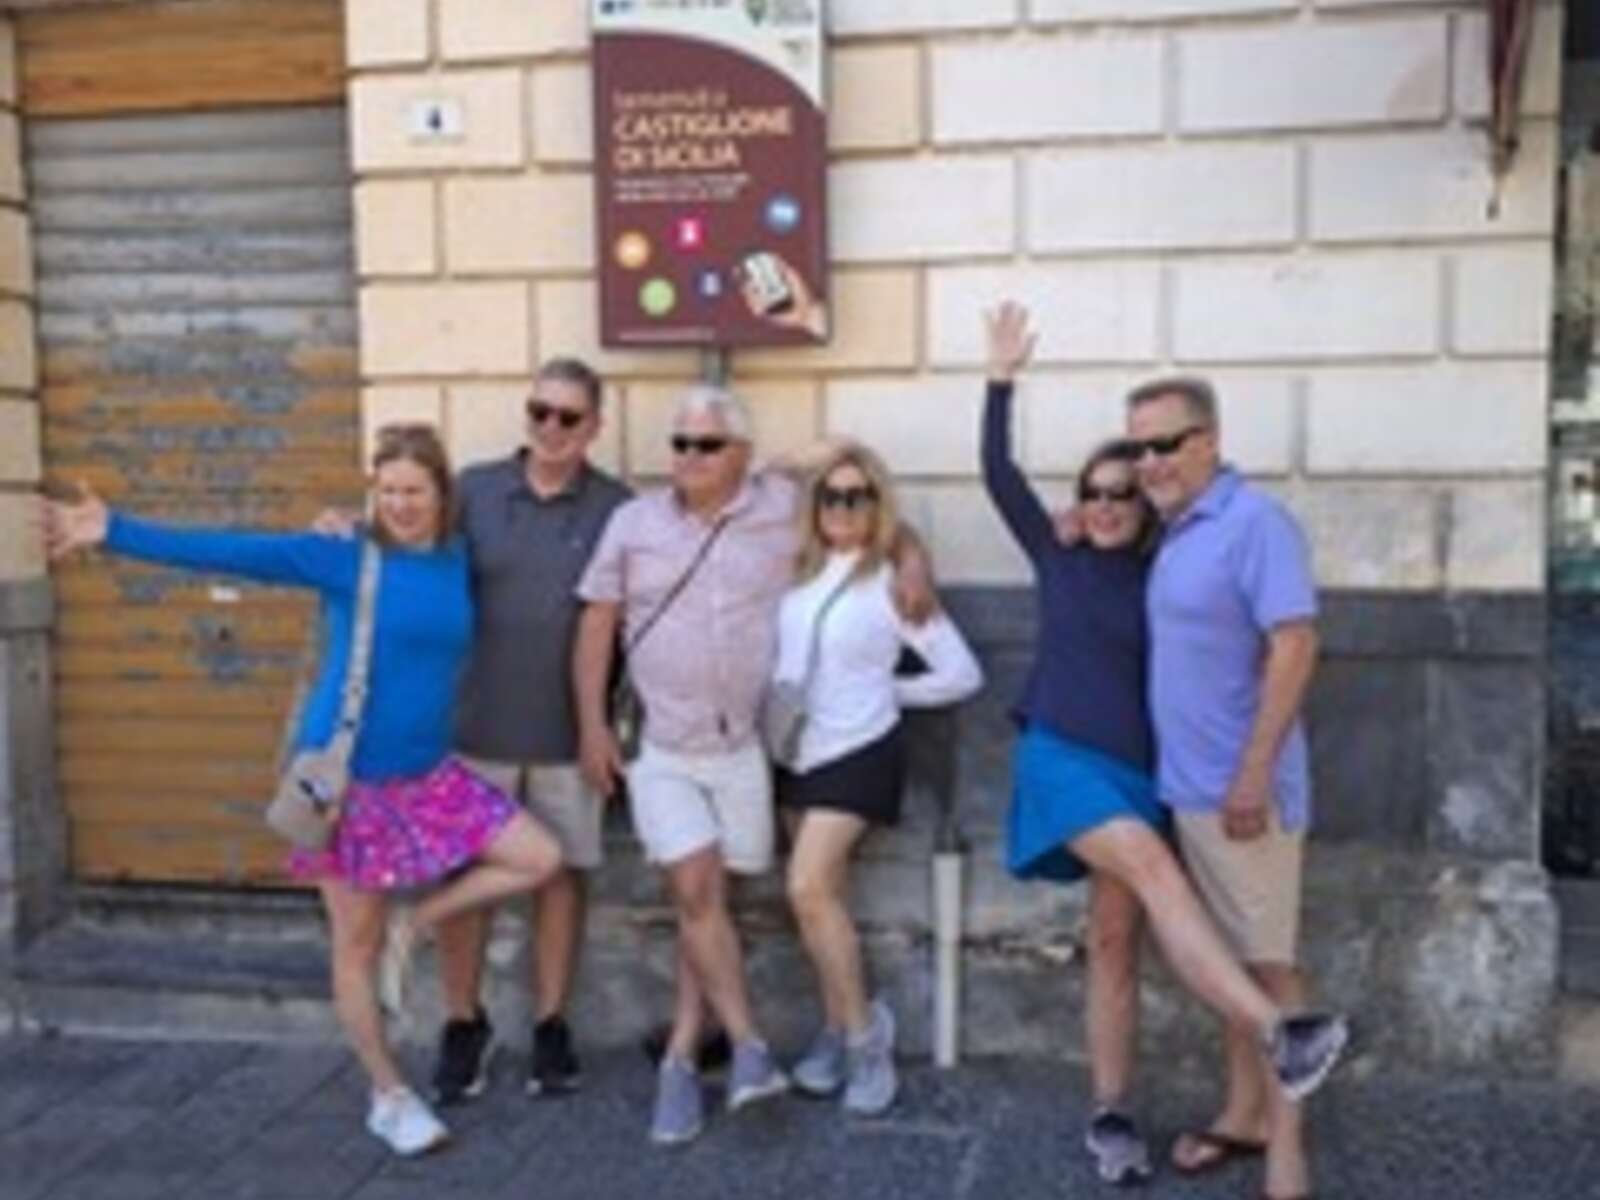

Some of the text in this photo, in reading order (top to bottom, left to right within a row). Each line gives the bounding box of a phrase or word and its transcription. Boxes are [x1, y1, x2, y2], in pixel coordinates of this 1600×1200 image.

[613, 106, 792, 141] CASTIGLIONE
[613, 140, 740, 171] DI SICILIA
